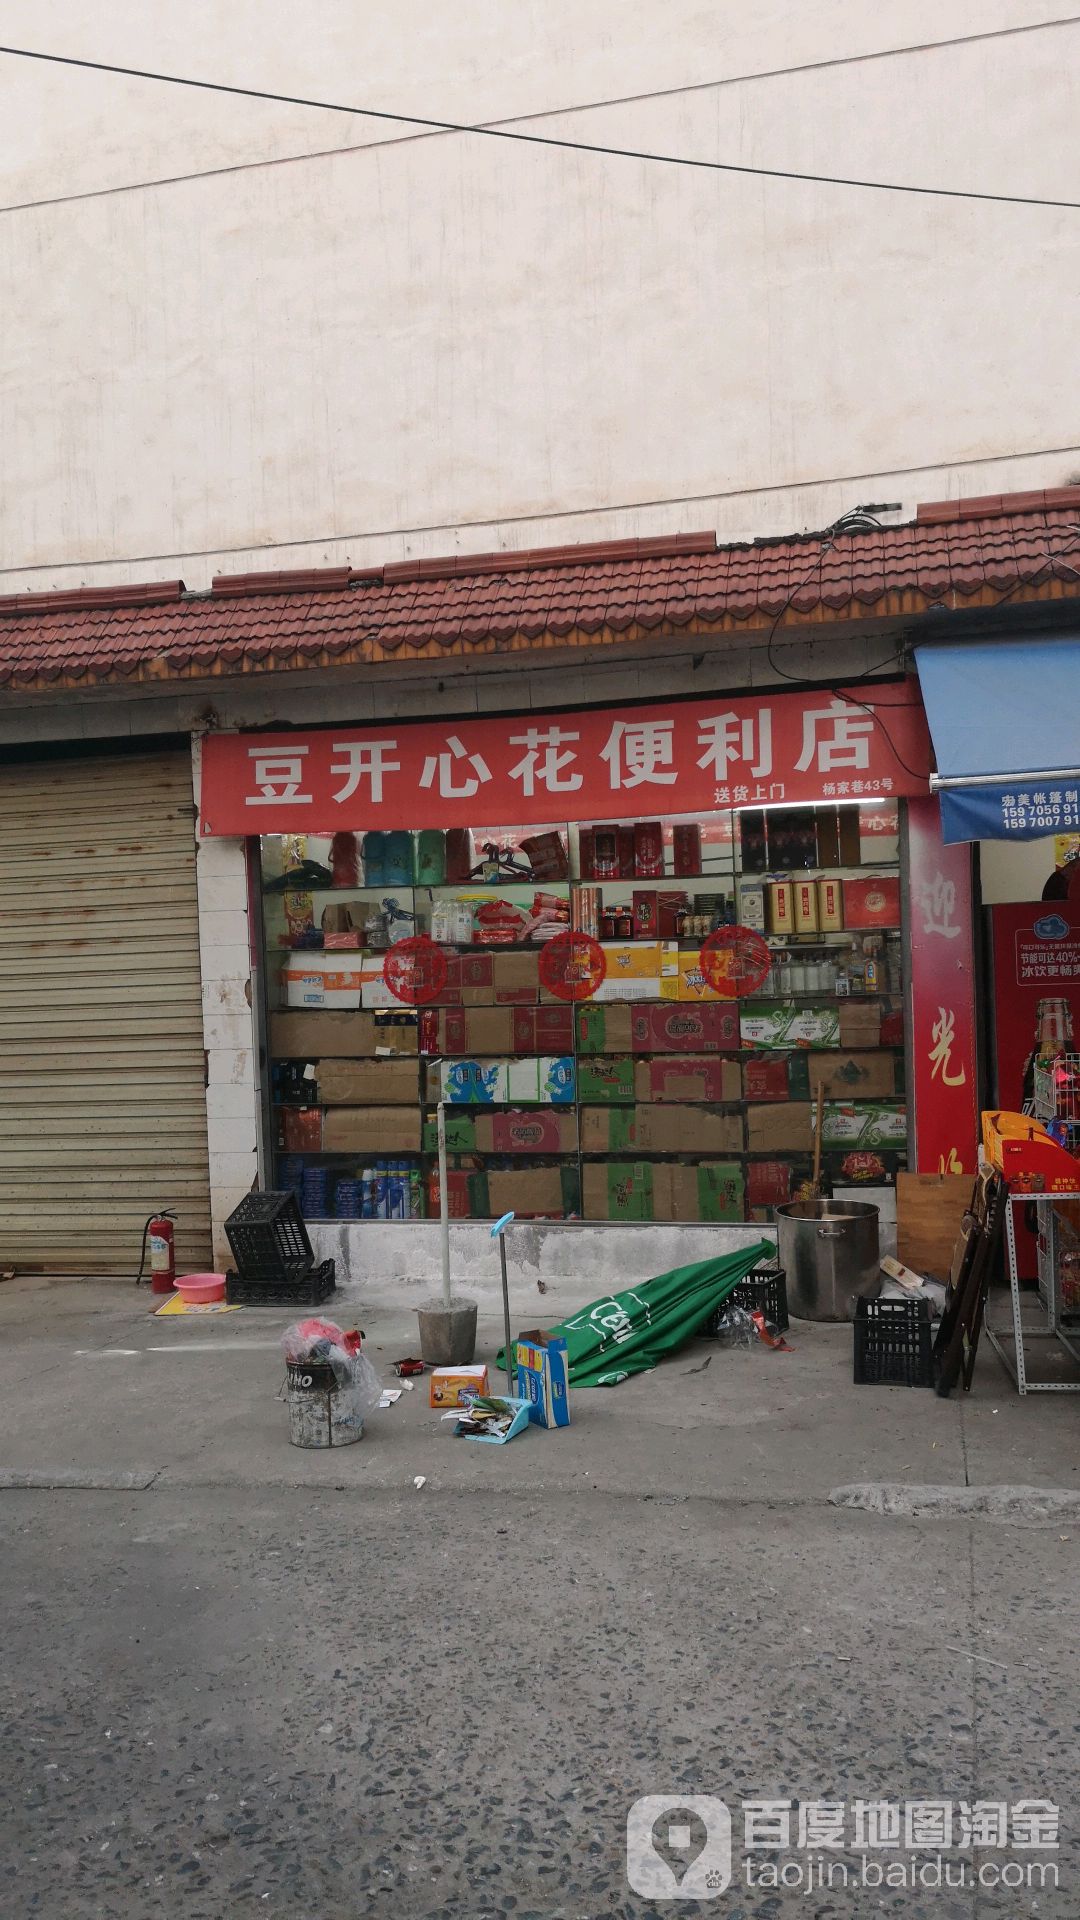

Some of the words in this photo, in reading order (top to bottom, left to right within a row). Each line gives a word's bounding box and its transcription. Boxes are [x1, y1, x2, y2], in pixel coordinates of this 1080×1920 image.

[245, 700, 876, 806] 豆开心花便利店
[714, 783, 785, 804] 送货上门
[822, 777, 894, 797] 杨家巷43号
[1002, 807, 1025, 818] 159
[1028, 804, 1060, 816] 7056
[1003, 818, 1026, 829] 159
[1029, 815, 1060, 828] 7007
[1020, 952, 1080, 965] 节能可达40%
